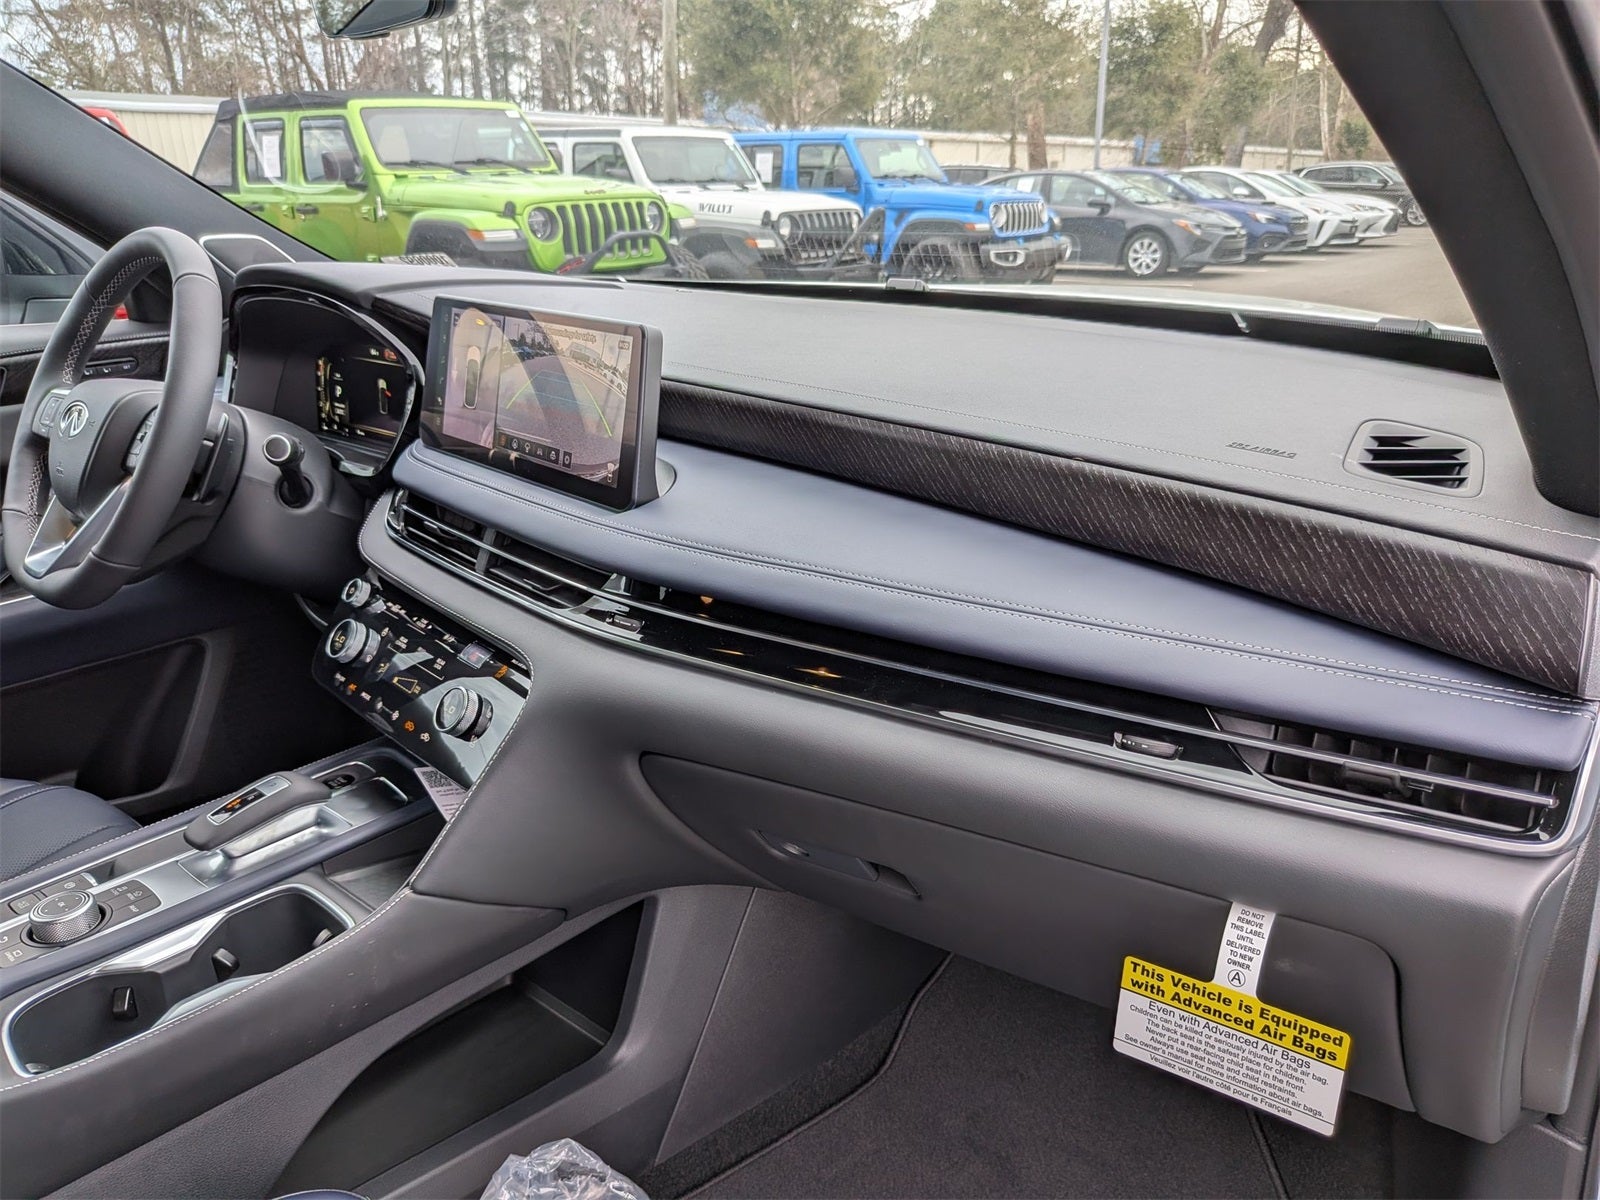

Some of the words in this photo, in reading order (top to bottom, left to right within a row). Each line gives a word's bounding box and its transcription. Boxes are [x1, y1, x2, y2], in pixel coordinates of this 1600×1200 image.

[1230, 922, 1244, 932] THIS
[1245, 928, 1266, 940] LABEL
[1236, 916, 1264, 930] REMOVE
[1236, 934, 1254, 944] UNTIL
[1240, 908, 1250, 917] DO
[1251, 912, 1265, 920] NOT
[1226, 939, 1261, 956] DELIVERED
[1226, 958, 1252, 972] OWNER.
[1230, 949, 1238, 958] TO
[1238, 952, 1254, 962] NEW
[1230, 972, 1242, 984] A
[1130, 960, 1165, 983] This
[1170, 974, 1232, 1007] Vehicle
[1238, 999, 1253, 1014] is
[1259, 1006, 1344, 1048] Equipped
[1130, 978, 1166, 998] with
[1170, 992, 1255, 1030] Advanced
[1259, 1024, 1287, 1042] Air
[1292, 1034, 1338, 1062] Bags
[1148, 1000, 1176, 1018] Even
[1178, 1013, 1200, 1028] with
[1202, 1021, 1259, 1049] Advanced
[1260, 1043, 1278, 1056] Air
[1280, 1050, 1311, 1069] Bags
[1124, 1033, 1138, 1044] See
[1139, 1040, 1166, 1055] owner's
[1167, 1051, 1194, 1066] manual
[1194, 1061, 1205, 1070] for
[1206, 1066, 1225, 1078] more
[1226, 1073, 1267, 1095] information
[1268, 1090, 1290, 1104] about
[1291, 1100, 1302, 1108] air
[1302, 1103, 1324, 1118] bags.
[1130, 1004, 1158, 1020] Children
[1160, 1016, 1173, 1025] can
[1174, 1020, 1184, 1030] be
[1184, 1025, 1204, 1037] killed
[1214, 1036, 1247, 1054] seriously
[1248, 1048, 1274, 1063] injured
[1274, 1058, 1285, 1069] by
[1286, 1064, 1298, 1073] the
[1300, 1069, 1311, 1078] air
[1312, 1072, 1329, 1086] bag.
[1146, 1026, 1166, 1039] Never
[1168, 1035, 1179, 1045] put
[1186, 1042, 1225, 1063] rear-facing
[1226, 1058, 1244, 1069] child
[1245, 1064, 1262, 1076] seat
[1263, 1072, 1270, 1080] in
[1272, 1074, 1284, 1085] the
[1286, 1080, 1306, 1094] front.
[1147, 1018, 1160, 1028] The
[1162, 1024, 1178, 1036] back
[1180, 1032, 1195, 1042] seat
[1204, 1040, 1216, 1050] the
[1217, 1046, 1240, 1058] safest
[1240, 1055, 1262, 1068] place
[1263, 1062, 1274, 1072] for
[1274, 1068, 1307, 1086] children.
[1149, 1036, 1175, 1051] Always
[1176, 1046, 1189, 1056] use
[1190, 1051, 1206, 1062] seat
[1207, 1057, 1225, 1070] belts
[1226, 1066, 1240, 1076] and
[1242, 1072, 1260, 1083] child
[1260, 1079, 1298, 1099] restraints.
[1150, 1054, 1177, 1070] Veuillez
[1178, 1066, 1192, 1076] voir
[1192, 1070, 1214, 1084] l'autre
[1215, 1080, 1232, 1092] côté
[1232, 1088, 1250, 1099] pour
[1251, 1094, 1259, 1102] le
[1260, 1098, 1293, 1116] Français
